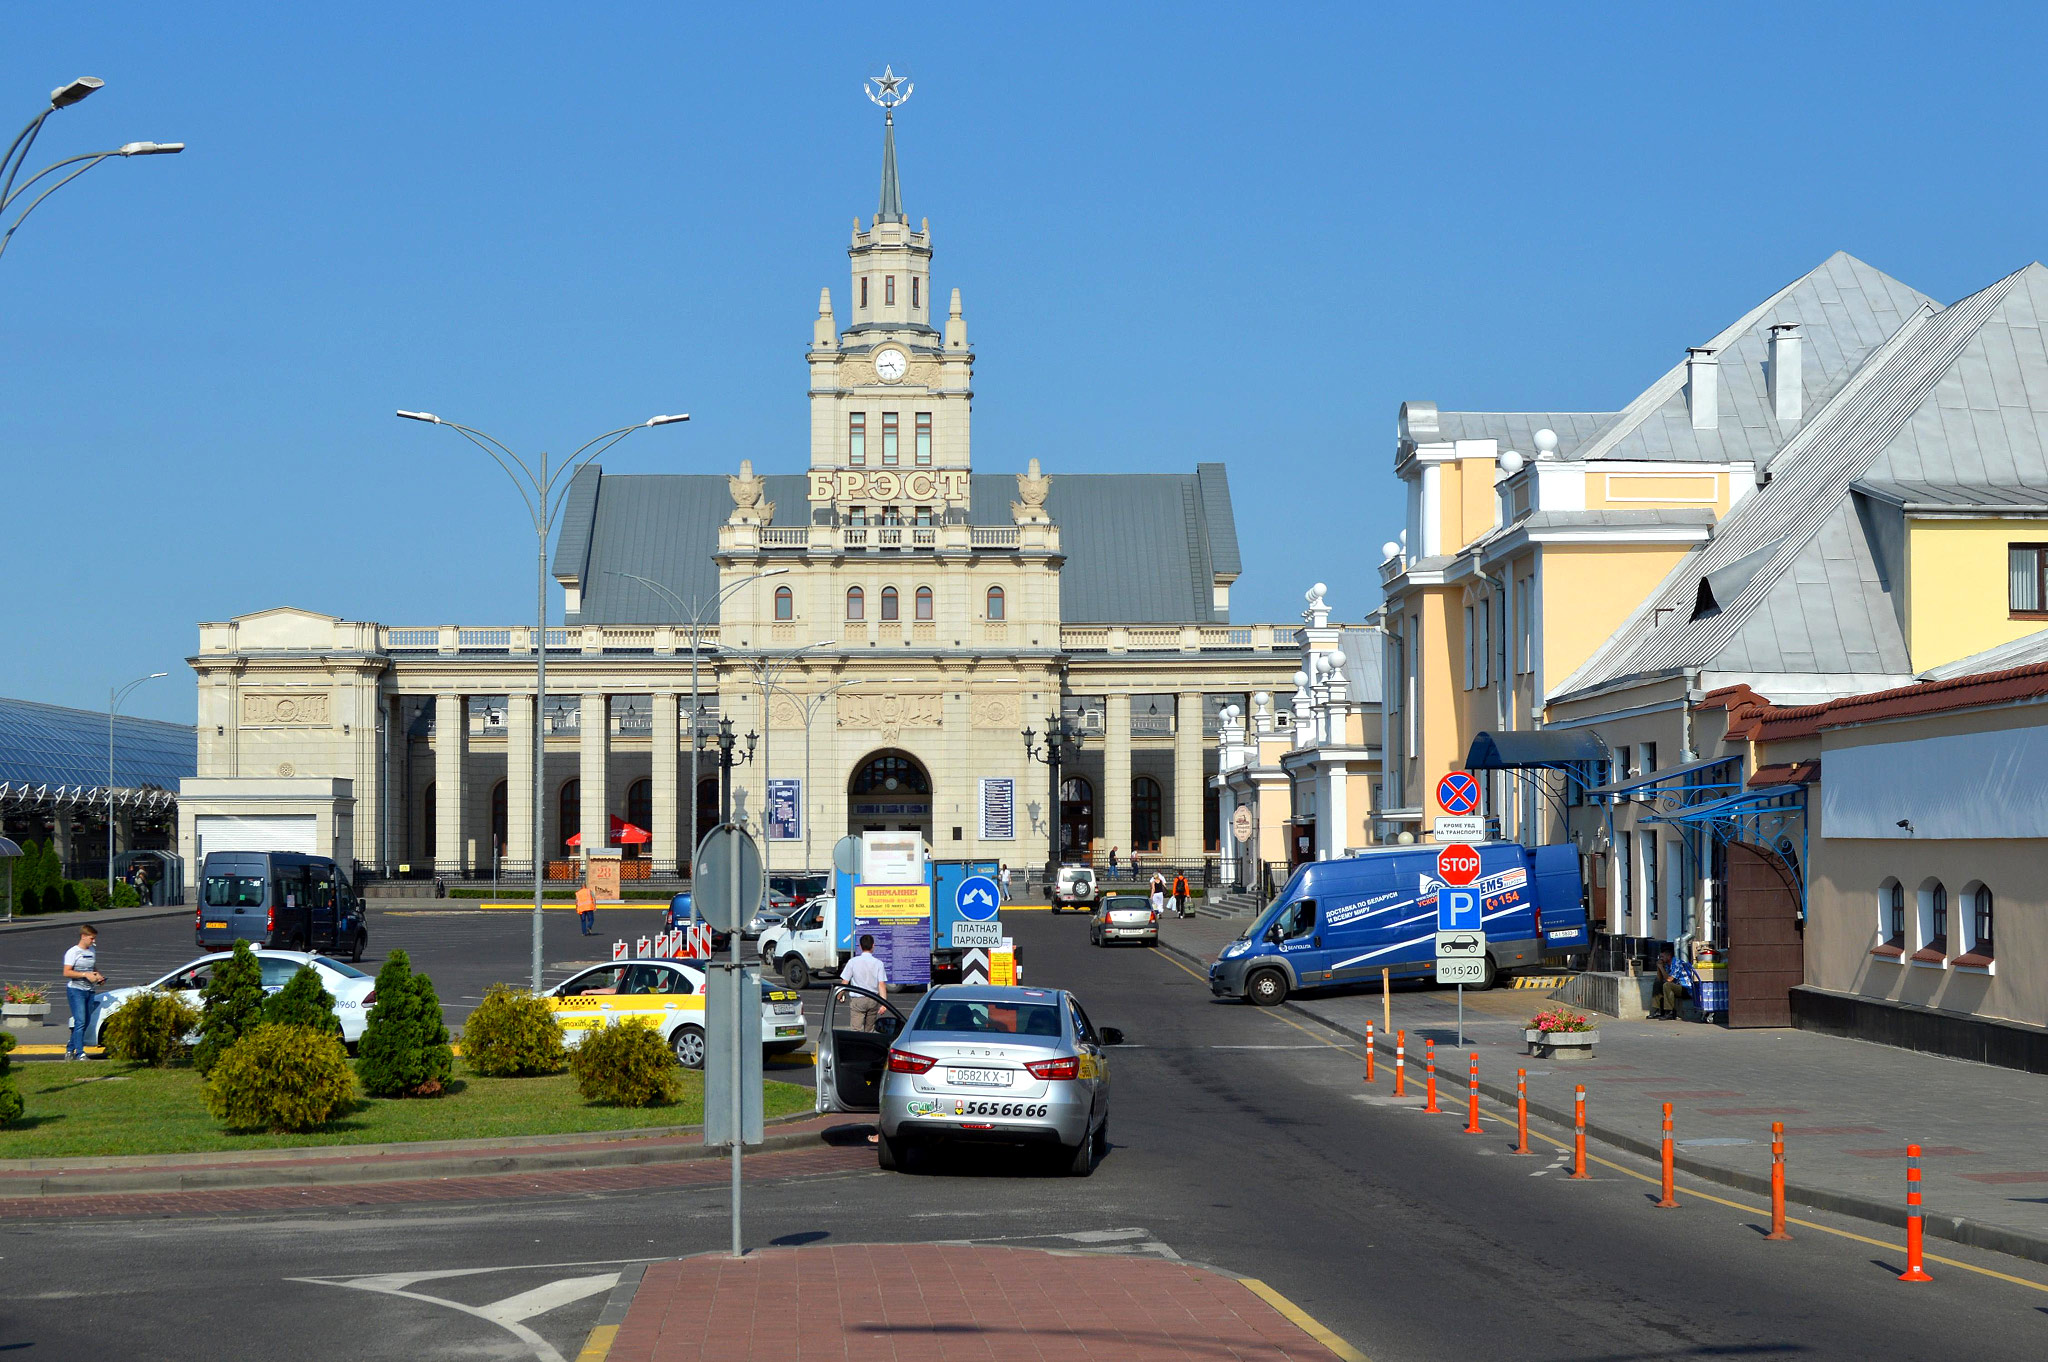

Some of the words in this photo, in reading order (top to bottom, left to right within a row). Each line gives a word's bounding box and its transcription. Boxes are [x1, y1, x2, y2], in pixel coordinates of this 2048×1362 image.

[807, 470, 969, 501] БРЭСТ
[1441, 858, 1478, 872] STOP
[1480, 878, 1504, 894] EMS
[1326, 902, 1356, 918] ДОСТАВКА
[1358, 900, 1367, 909] ПО
[1367, 891, 1398, 906] БЕЛАРУСИ
[1499, 891, 1519, 905] 154
[1333, 910, 1353, 922] ВСЕМУ
[1354, 906, 1370, 917] МИРУ
[1451, 893, 1473, 926] P
[957, 925, 998, 933] ПЛАТНАЯ
[953, 936, 999, 944] ПАРКОВКА
[1441, 967, 1450, 975] 10
[1452, 966, 1464, 975] 15
[1466, 966, 1480, 975] 20
[337, 1001, 356, 1009] 1960
[957, 1070, 982, 1081] 0582
